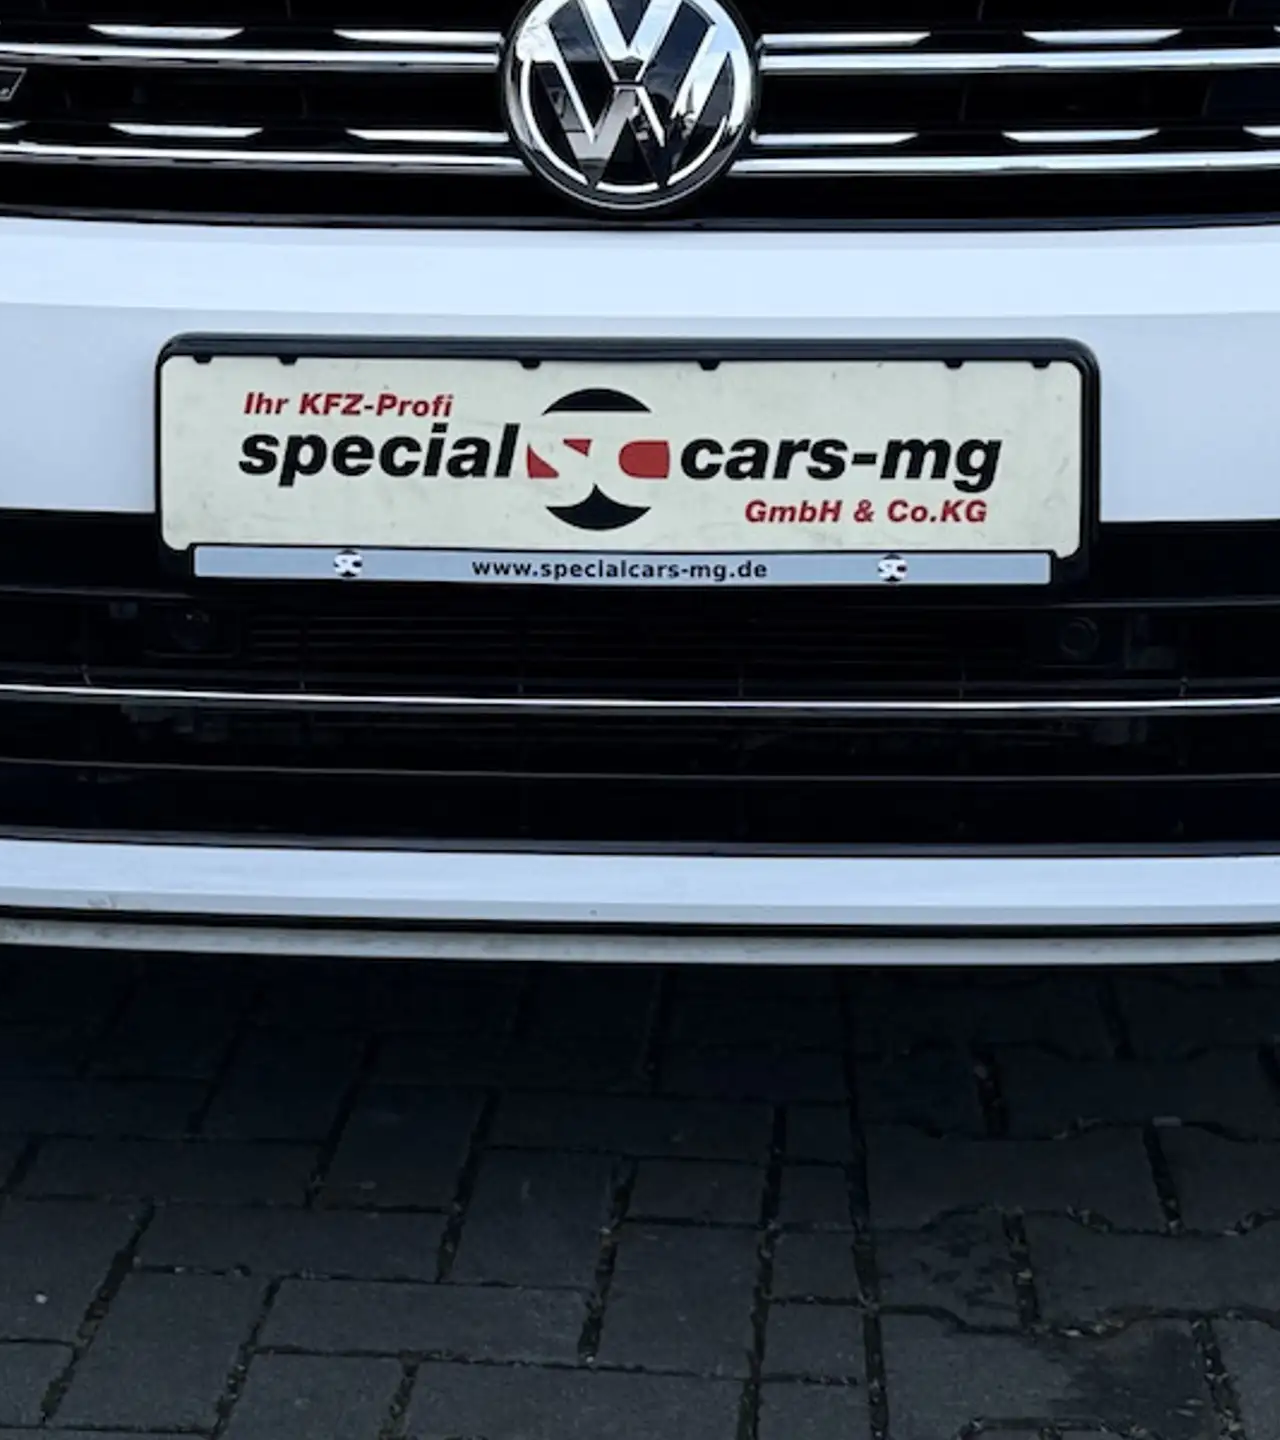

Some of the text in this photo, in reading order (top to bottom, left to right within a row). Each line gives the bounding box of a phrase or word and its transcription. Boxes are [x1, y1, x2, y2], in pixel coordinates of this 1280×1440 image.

[243, 391, 453, 417] Ihr KFZ-Profi
[238, 422, 520, 487] special
[681, 438, 1002, 493] cars-mg
[744, 499, 987, 523] GmbH & Co.KG
[472, 557, 767, 581] www.specialcars-mg.de
